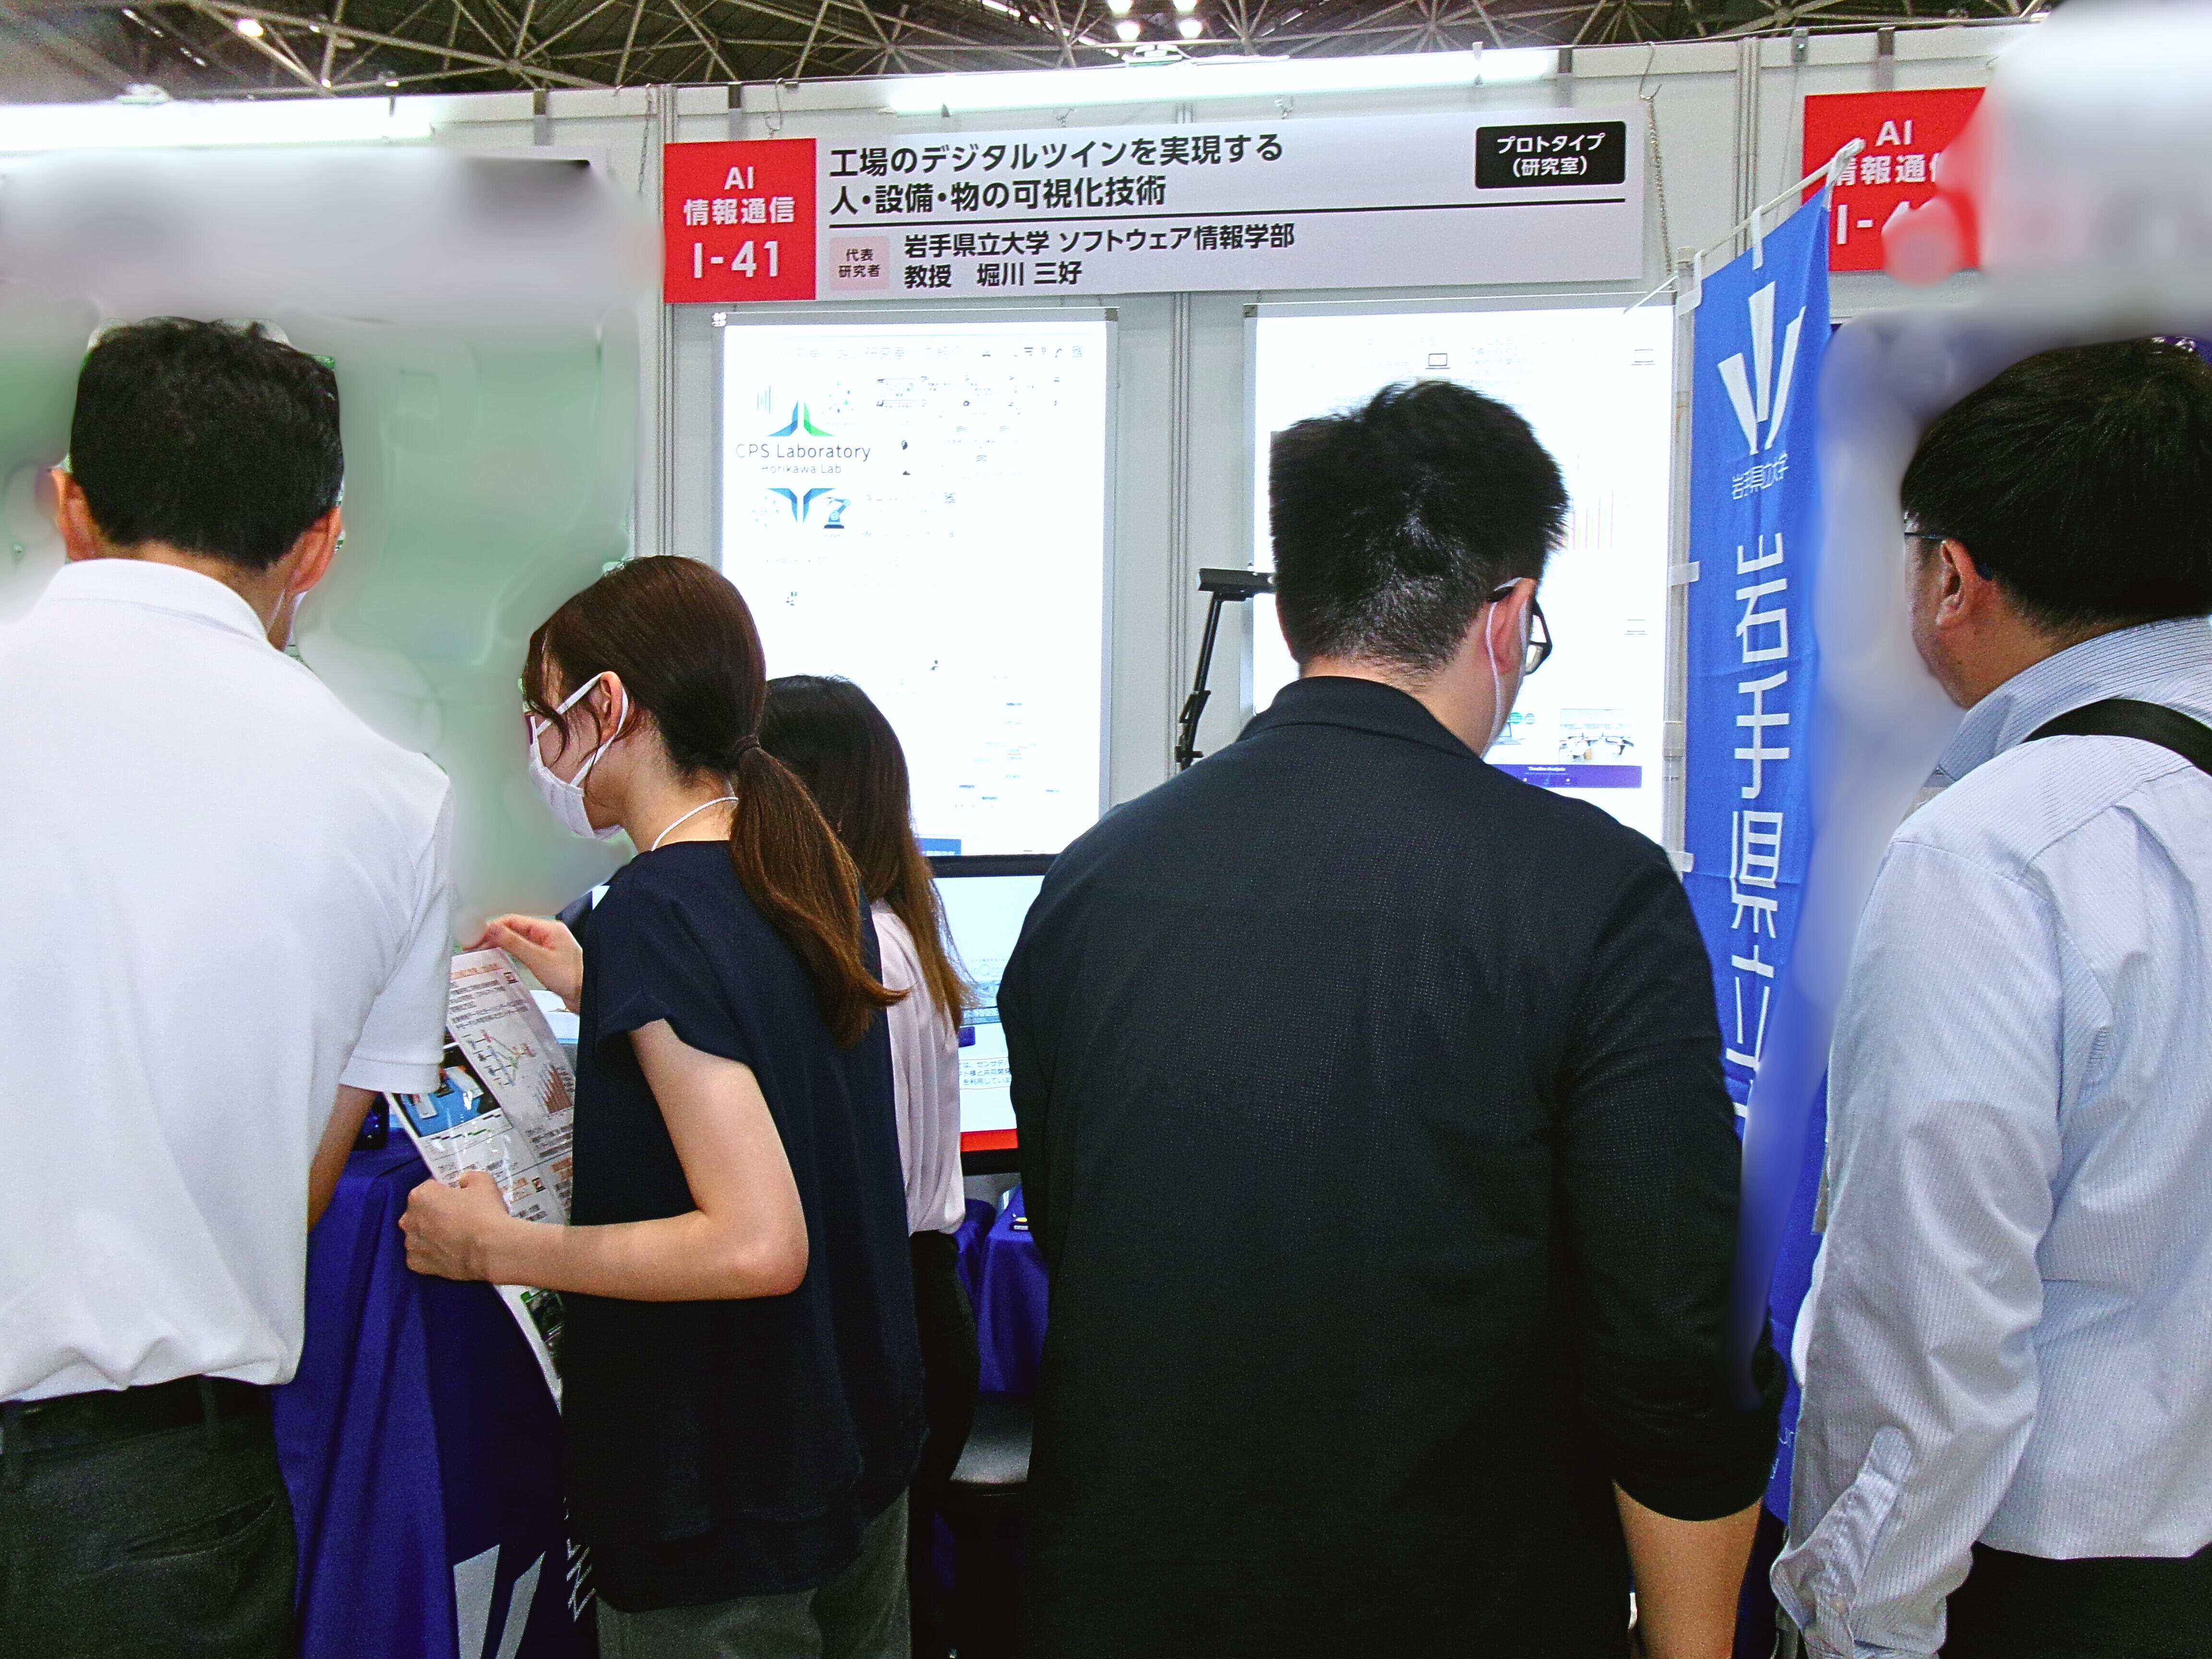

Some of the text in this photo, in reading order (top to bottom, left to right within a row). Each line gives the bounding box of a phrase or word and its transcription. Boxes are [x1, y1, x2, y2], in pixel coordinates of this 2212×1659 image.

[1497, 132, 1606, 154] プロトタイプ
[1877, 120, 1912, 146] AI
[830, 133, 1283, 177] 工場のデジタルツインを実現する
[1513, 156, 1587, 178] (研究室)
[724, 166, 754, 190] AI
[1827, 152, 1941, 186] 報通
[830, 175, 1166, 215] 人・設備・物の可視化技術
[683, 196, 795, 226] 情報通信
[905, 223, 1295, 259] 岩手県立大学 ソフトウェア情報学部
[694, 240, 778, 278] I-41
[845, 248, 874, 262] 代表
[838, 264, 881, 278] 研究者
[904, 261, 1082, 289] 教授 堀川 三好
[736, 443, 871, 462] CPS Laboratory
[821, 464, 842, 474] Lab
[1726, 532, 1790, 1118] 岩手県立
